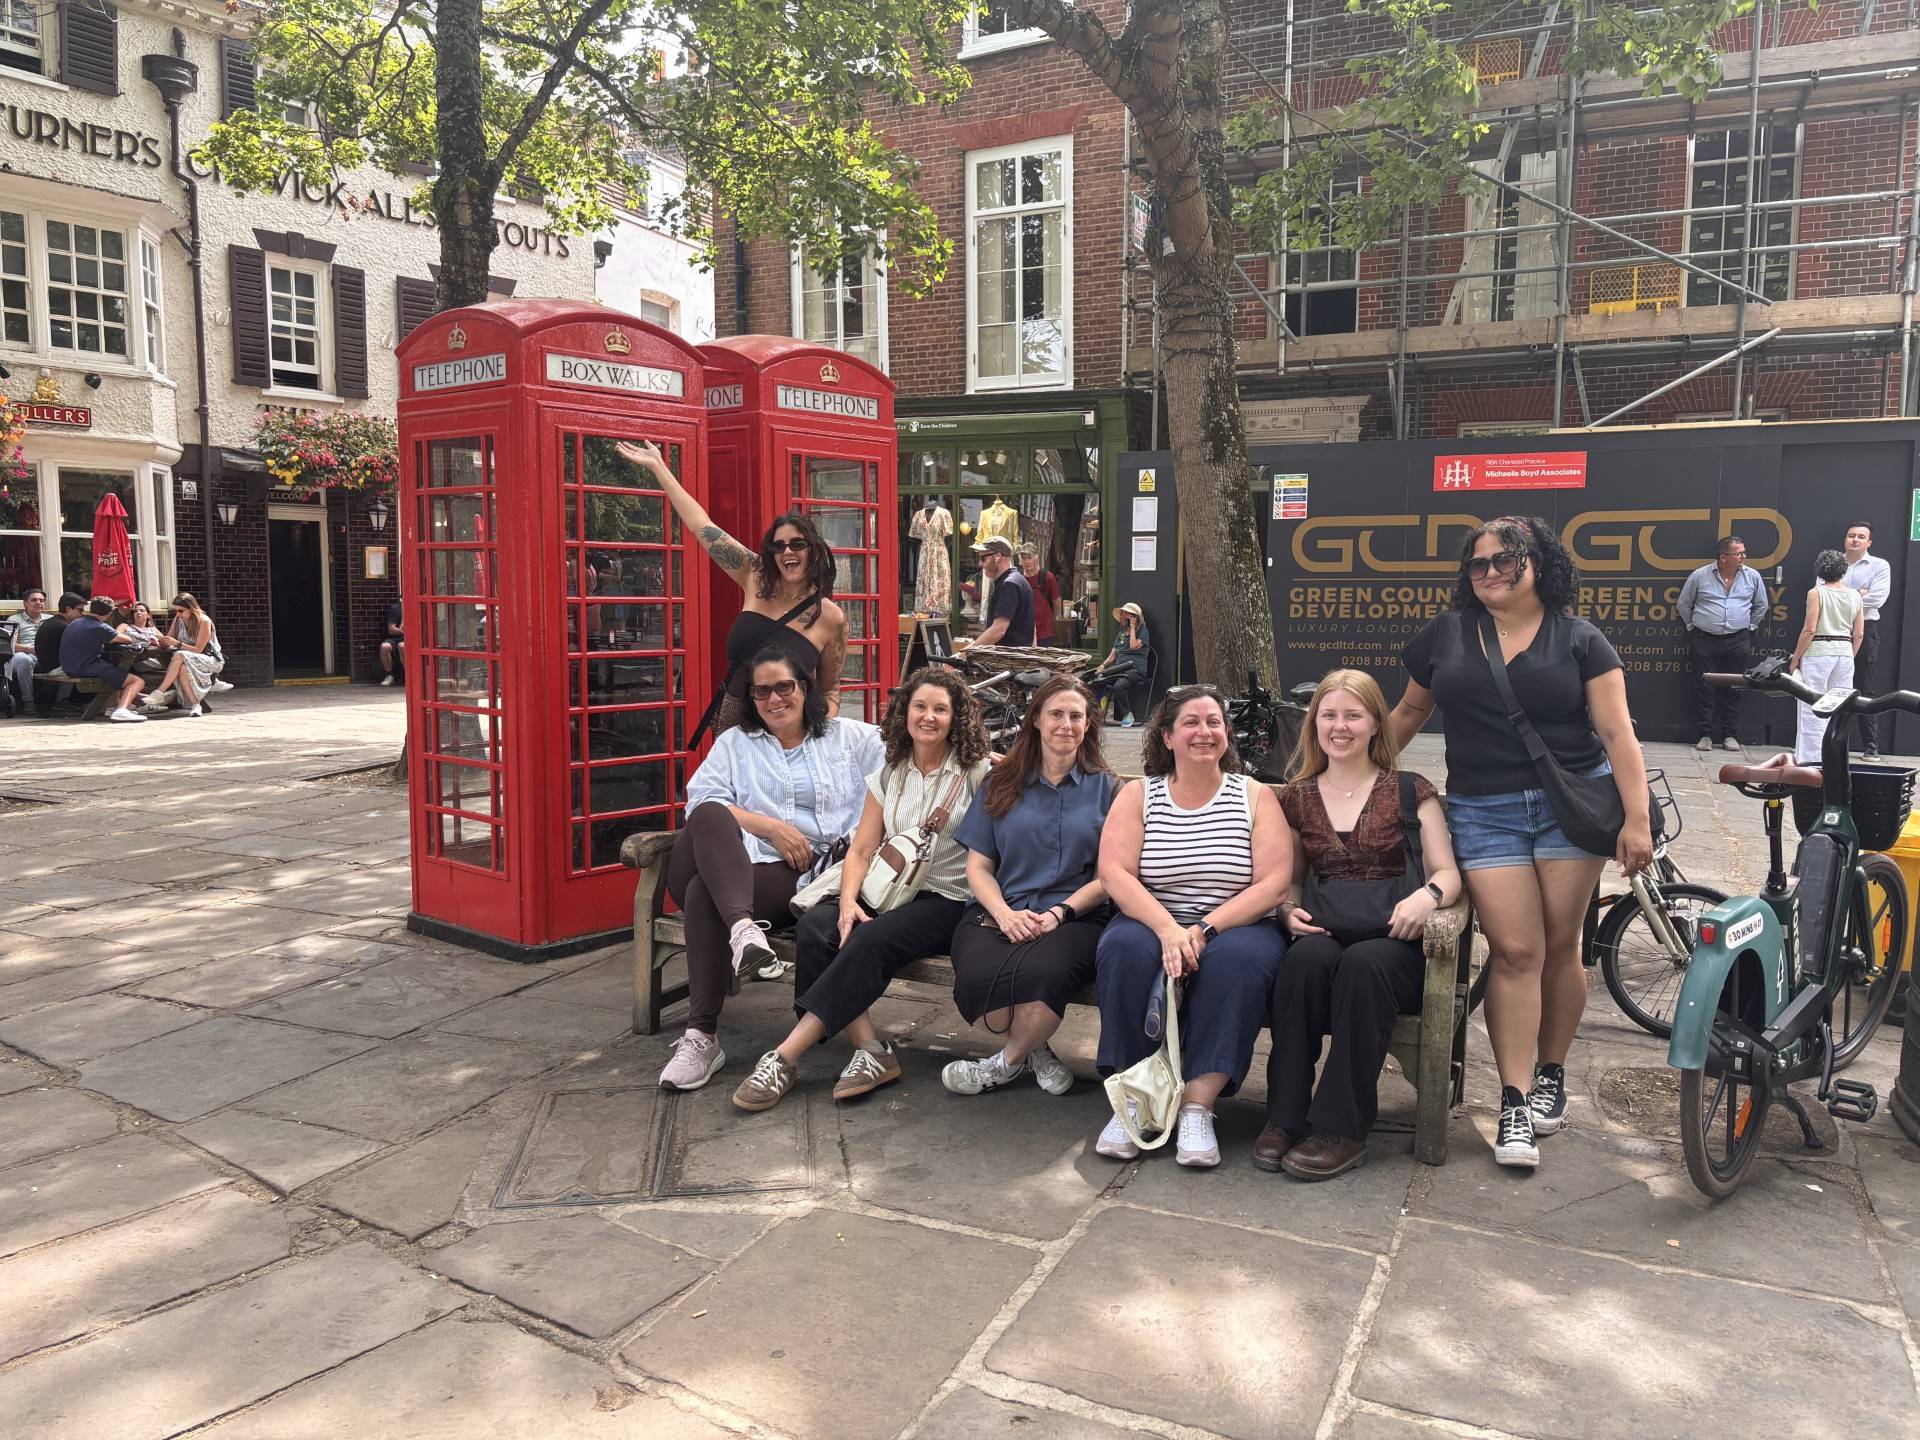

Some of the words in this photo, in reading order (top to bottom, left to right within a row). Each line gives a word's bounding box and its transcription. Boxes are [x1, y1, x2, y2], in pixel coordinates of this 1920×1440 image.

[0, 103, 162, 168] URNER'S
[492, 218, 571, 258] OUTS
[418, 356, 504, 387] TELEPHONE
[562, 360, 601, 382] BOX
[605, 366, 670, 391] WALKS
[781, 387, 875, 417] TELEPHONE
[21, 406, 85, 424] ULLER'S
[1485, 470, 1519, 478] Michaelis
[1520, 468, 1540, 477] Boyd
[1541, 467, 1582, 477] Associates
[1562, 508, 1793, 571] GCD
[1289, 587, 1372, 603] GREEN
[1380, 587, 1458, 603] COUN
[1578, 587, 1653, 603] REEN
[1289, 603, 1450, 619] DEVELOPME
[1288, 624, 1349, 633] LUXURY
[1288, 640, 1382, 651] www.gcdltd.com
[1341, 656, 1371, 666] 0208
[1374, 656, 1397, 666] 878
[1625, 661, 1650, 672] 208
[1655, 661, 1680, 672] 878
